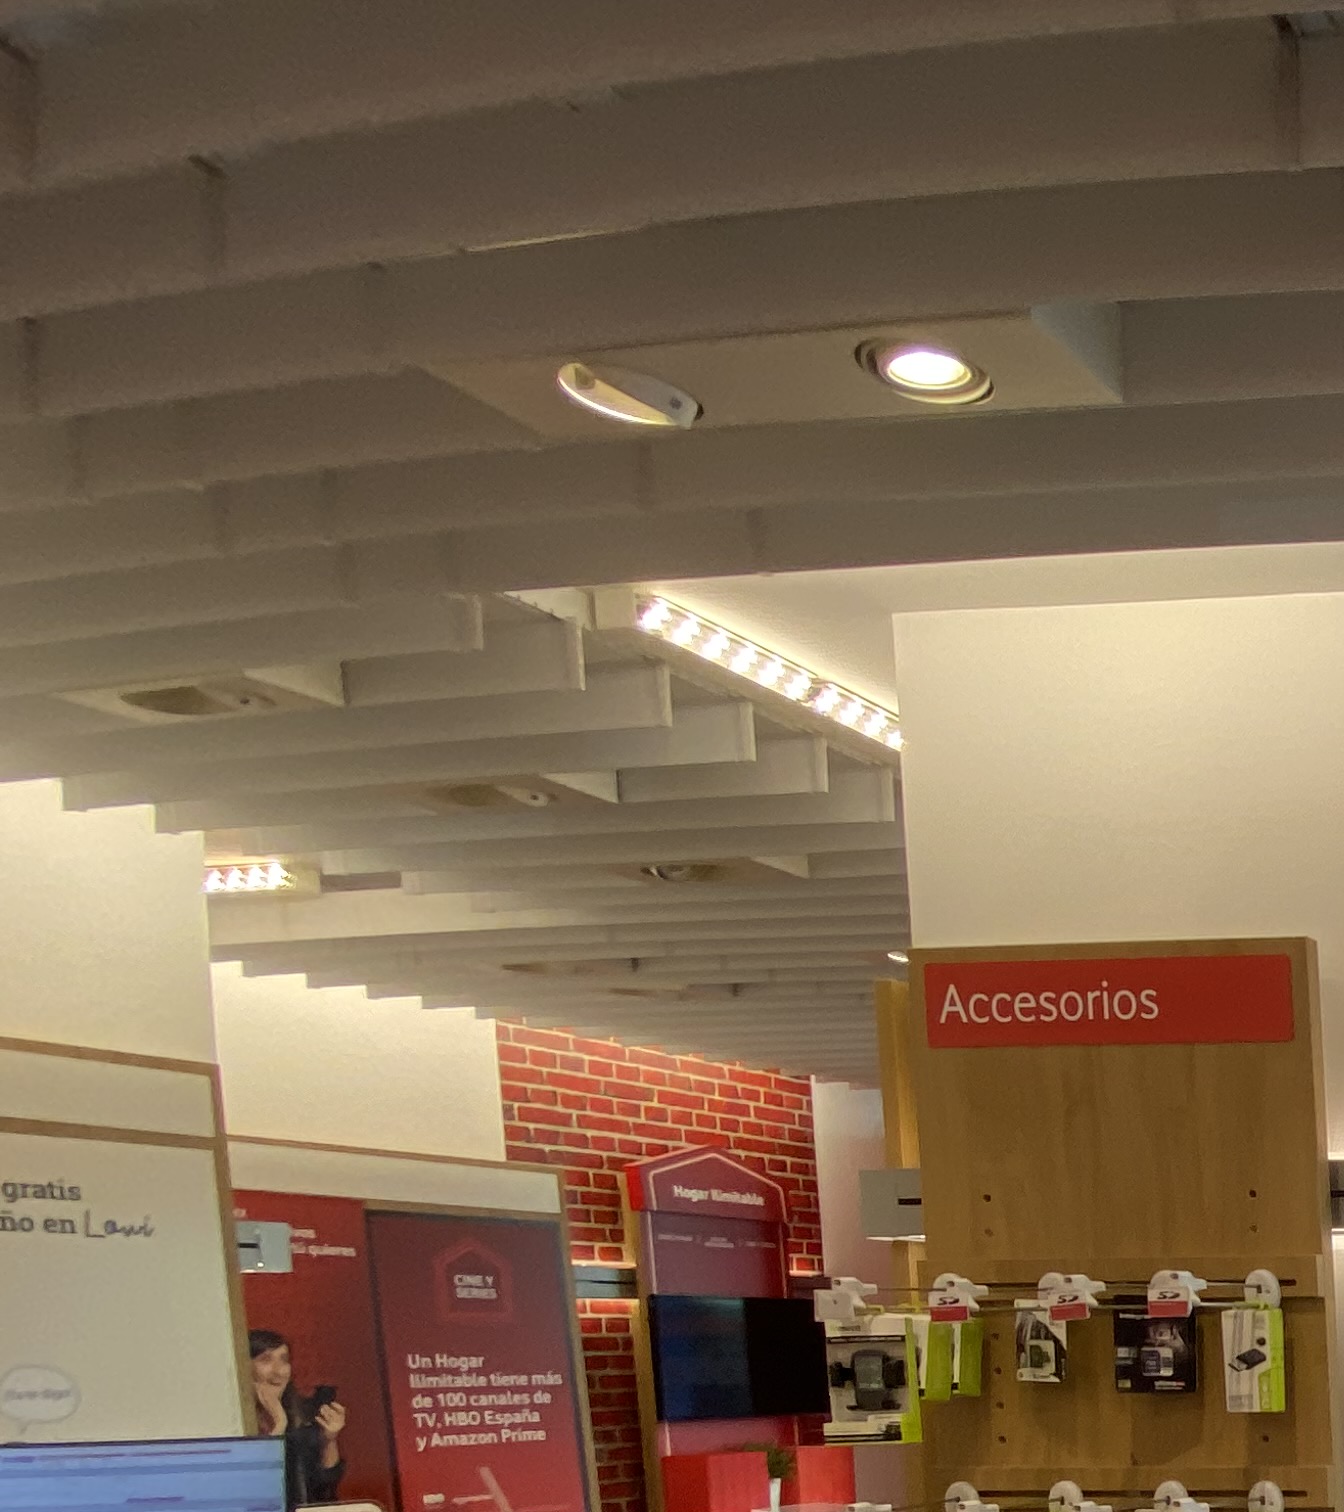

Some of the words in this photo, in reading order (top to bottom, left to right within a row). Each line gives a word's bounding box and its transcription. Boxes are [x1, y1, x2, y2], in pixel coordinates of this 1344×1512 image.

[939, 980, 1160, 1025] Accesorios
[1, 1178, 82, 1204] gratis
[0, 1210, 35, 1233] ño
[43, 1217, 77, 1234] en
[407, 1353, 432, 1369] Un
[434, 1353, 485, 1371] Hogar
[489, 1371, 529, 1386] tiene
[530, 1369, 563, 1386] más
[411, 1393, 433, 1409] de
[436, 1391, 467, 1407] 100
[469, 1389, 531, 1407] canales
[532, 1389, 553, 1405] de
[412, 1411, 443, 1430] TV,
[443, 1410, 481, 1427] HBO
[484, 1408, 541, 1427] España
[415, 1434, 428, 1453] y
[430, 1430, 498, 1448] Amazon
[500, 1427, 547, 1443] Prime
